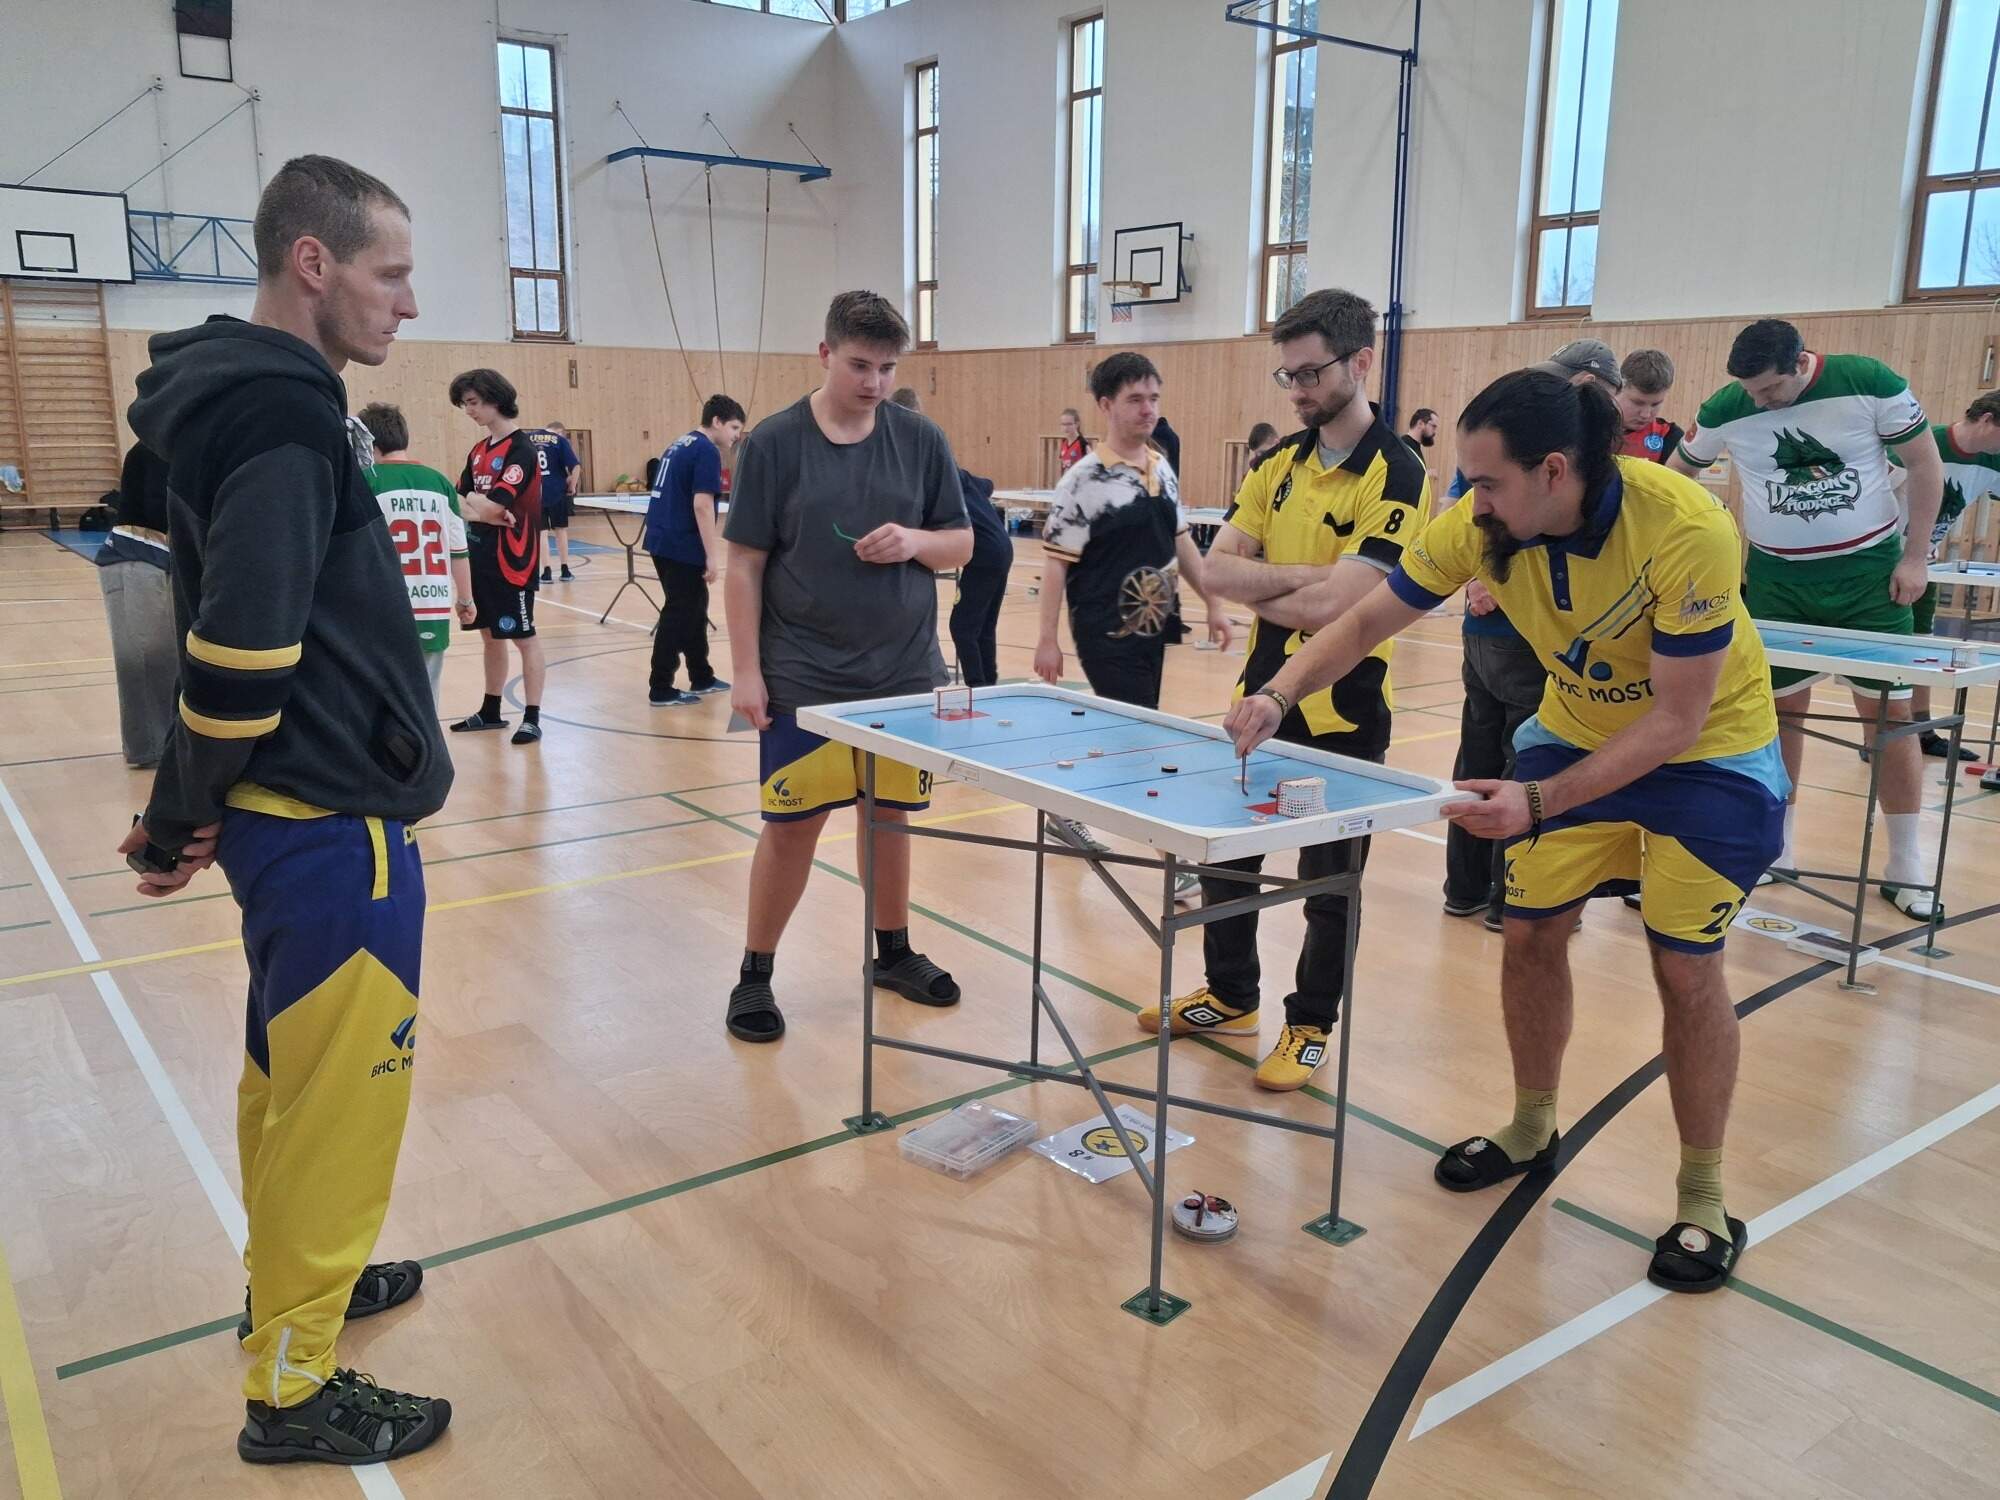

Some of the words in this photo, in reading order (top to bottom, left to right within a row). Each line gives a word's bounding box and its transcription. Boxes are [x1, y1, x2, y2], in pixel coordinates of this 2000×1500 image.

[537, 450, 548, 470] 6
[655, 458, 670, 487] 11
[1769, 469, 1859, 507] DRAGONS
[390, 497, 427, 512] PARTL
[1383, 508, 1405, 534] 8
[388, 518, 448, 575] 22
[1690, 587, 1731, 612] MOST
[1588, 678, 1655, 704] MOST
[778, 797, 804, 807] MOST
[371, 1058, 397, 1078] BHC
